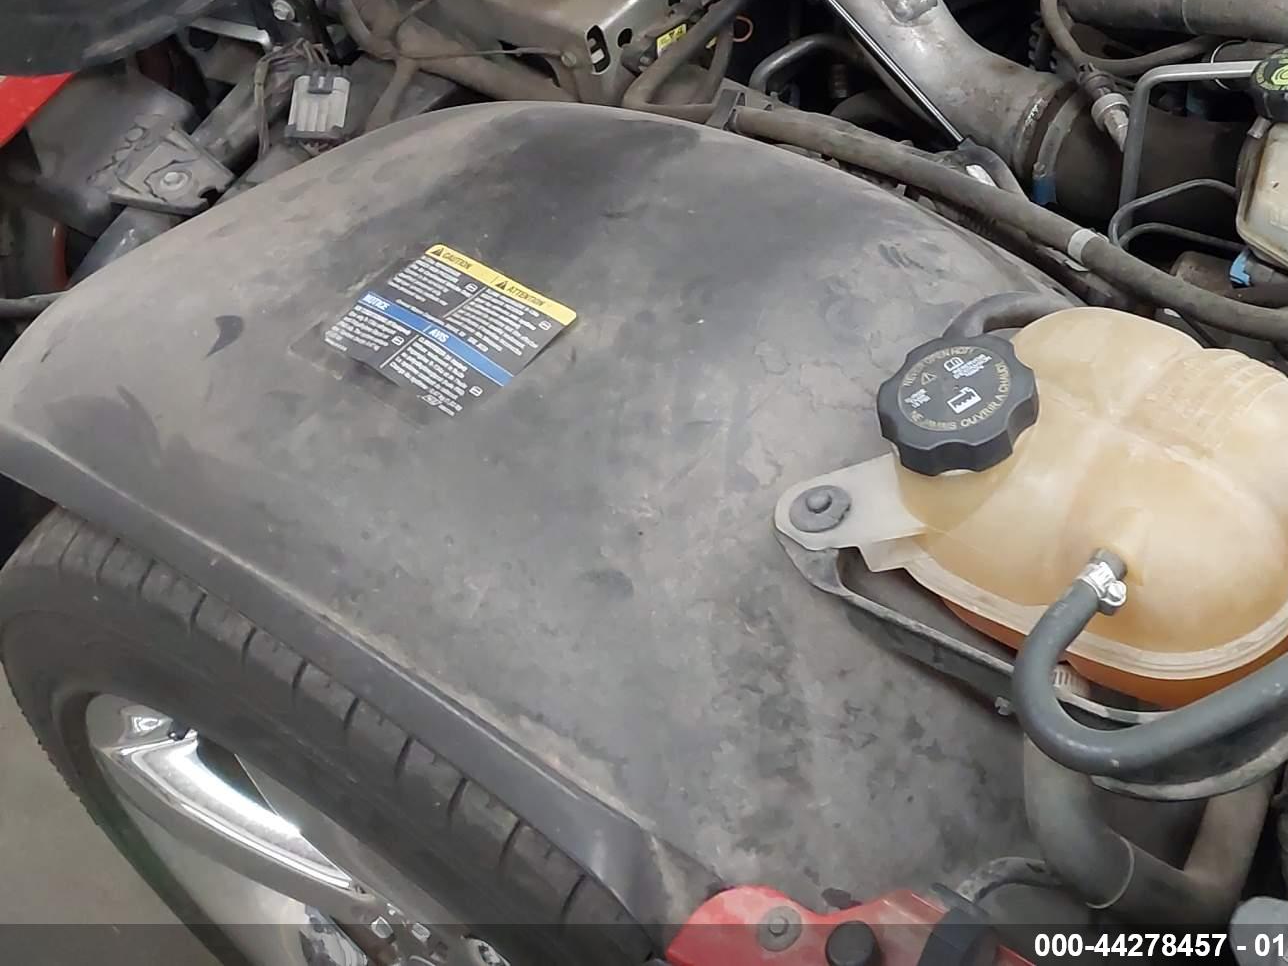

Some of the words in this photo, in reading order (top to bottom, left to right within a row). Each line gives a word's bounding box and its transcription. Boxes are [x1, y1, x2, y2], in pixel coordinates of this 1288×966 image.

[442, 252, 472, 270] CAUTION
[507, 285, 546, 306] ATTENTION
[428, 328, 450, 343] AVIS
